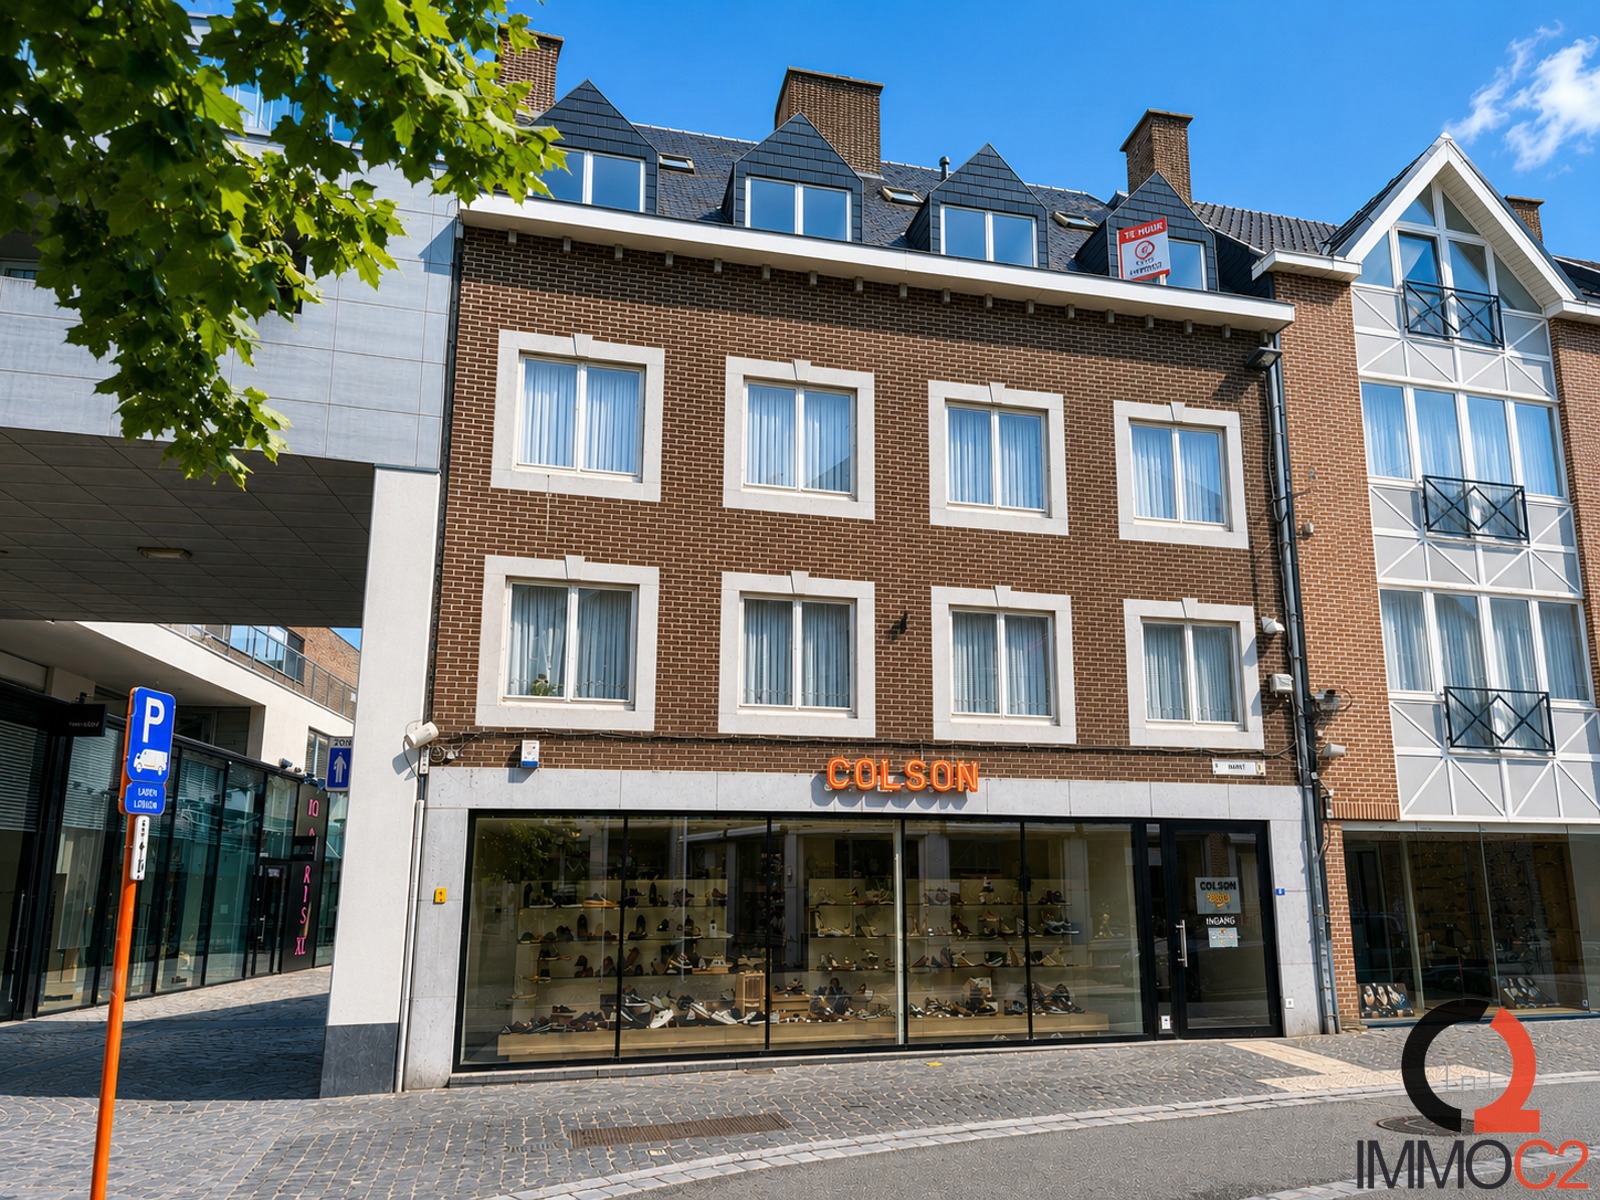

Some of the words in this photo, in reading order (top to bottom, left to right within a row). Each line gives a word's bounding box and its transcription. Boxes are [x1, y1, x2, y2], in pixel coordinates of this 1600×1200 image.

[1138, 222, 1163, 236] HUUR
[142, 696, 165, 743] P
[827, 757, 979, 792] COLSON
[1200, 881, 1236, 891] COLSON
